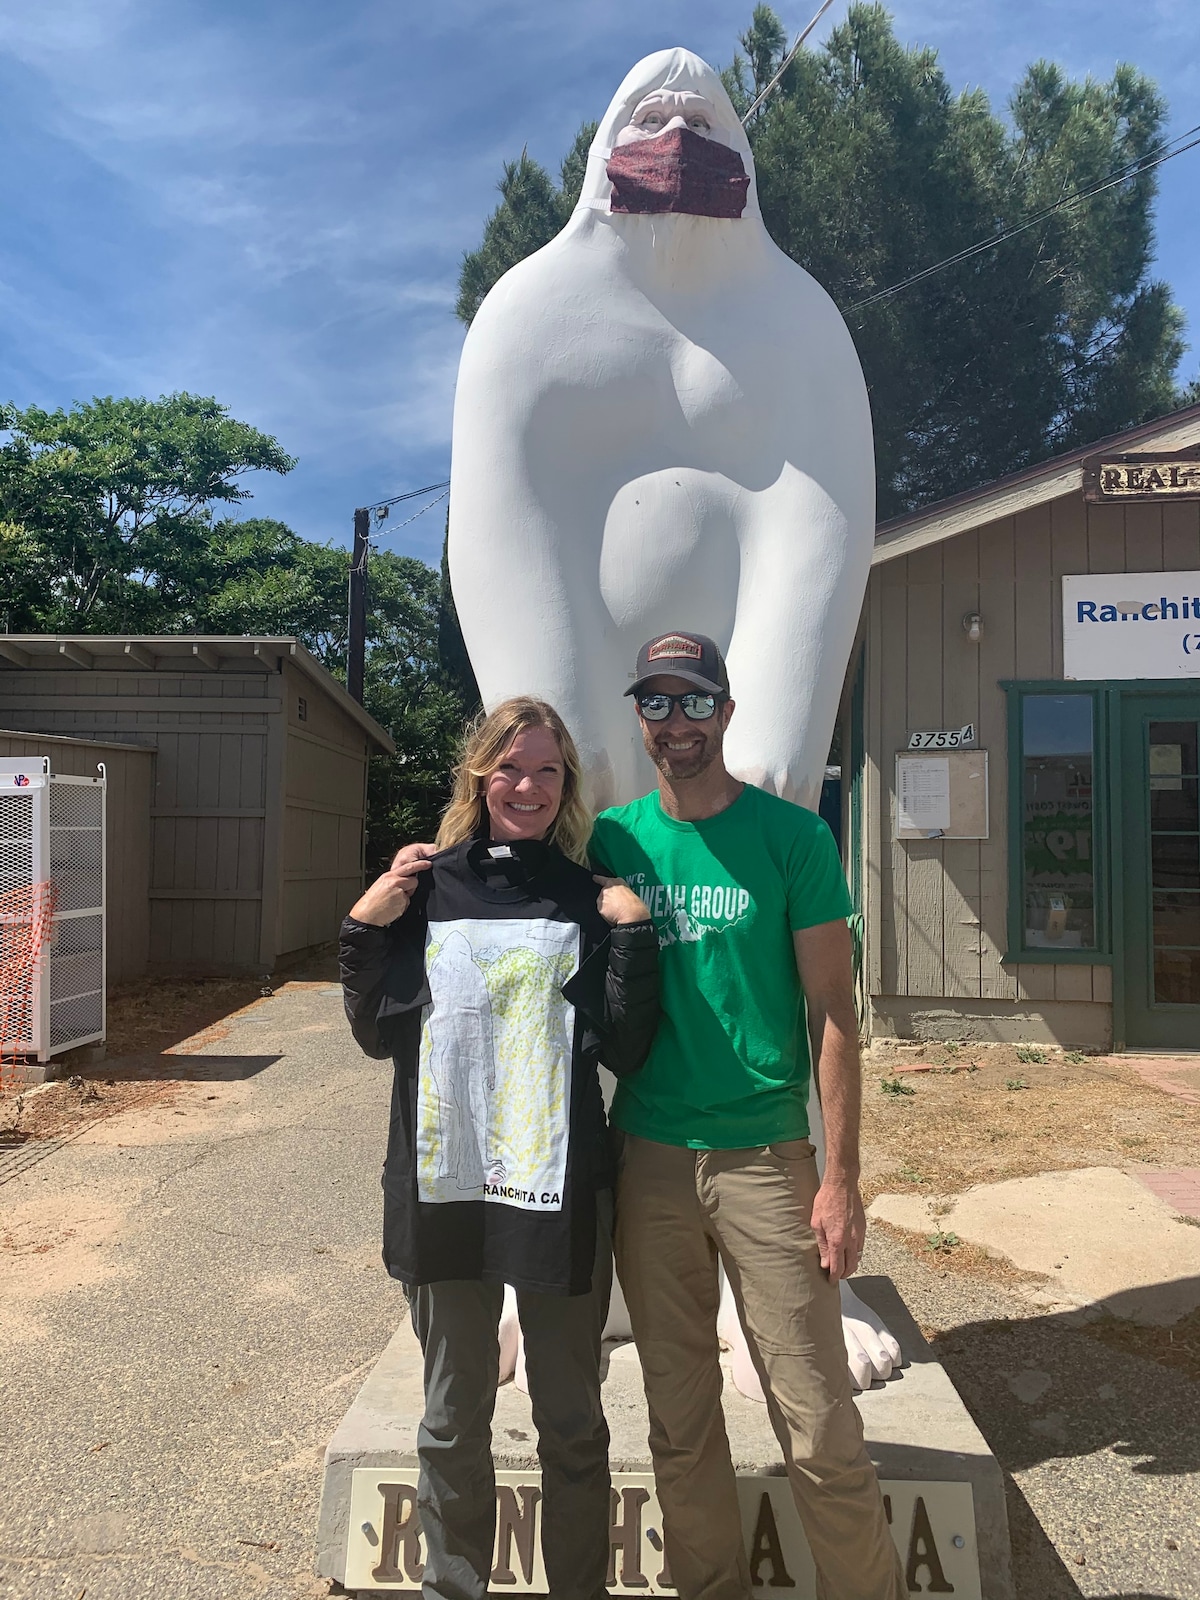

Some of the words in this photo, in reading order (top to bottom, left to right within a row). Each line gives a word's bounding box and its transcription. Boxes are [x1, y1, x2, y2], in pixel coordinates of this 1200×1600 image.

[1102, 466, 1188, 489] REAL
[633, 884, 686, 917] WEAH
[691, 884, 749, 921] GROUP
[483, 1183, 536, 1204] RANCHITA
[540, 1192, 561, 1205] CA
